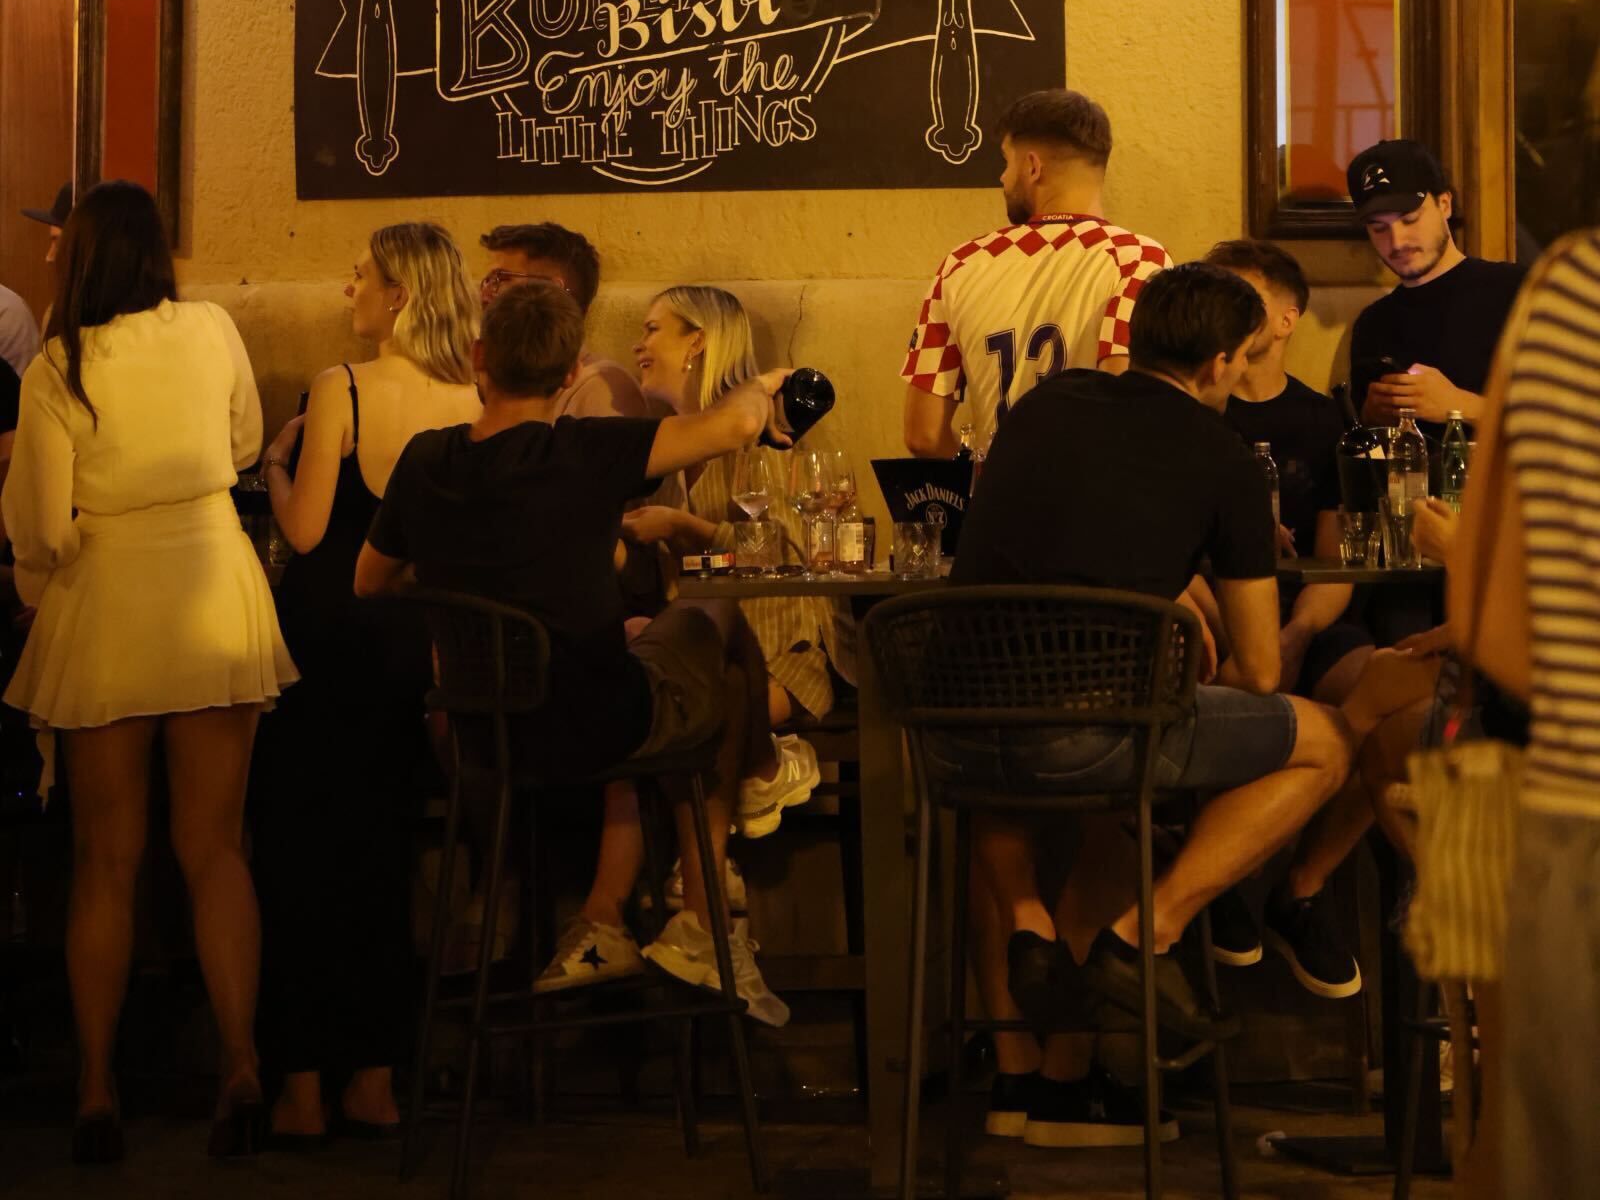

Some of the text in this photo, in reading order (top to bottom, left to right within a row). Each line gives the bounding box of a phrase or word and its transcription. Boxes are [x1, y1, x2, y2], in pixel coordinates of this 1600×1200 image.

[534, 40, 800, 135] Enjoy the
[496, 93, 817, 166] LITTLE THINGS
[904, 488, 926, 510] JACK
